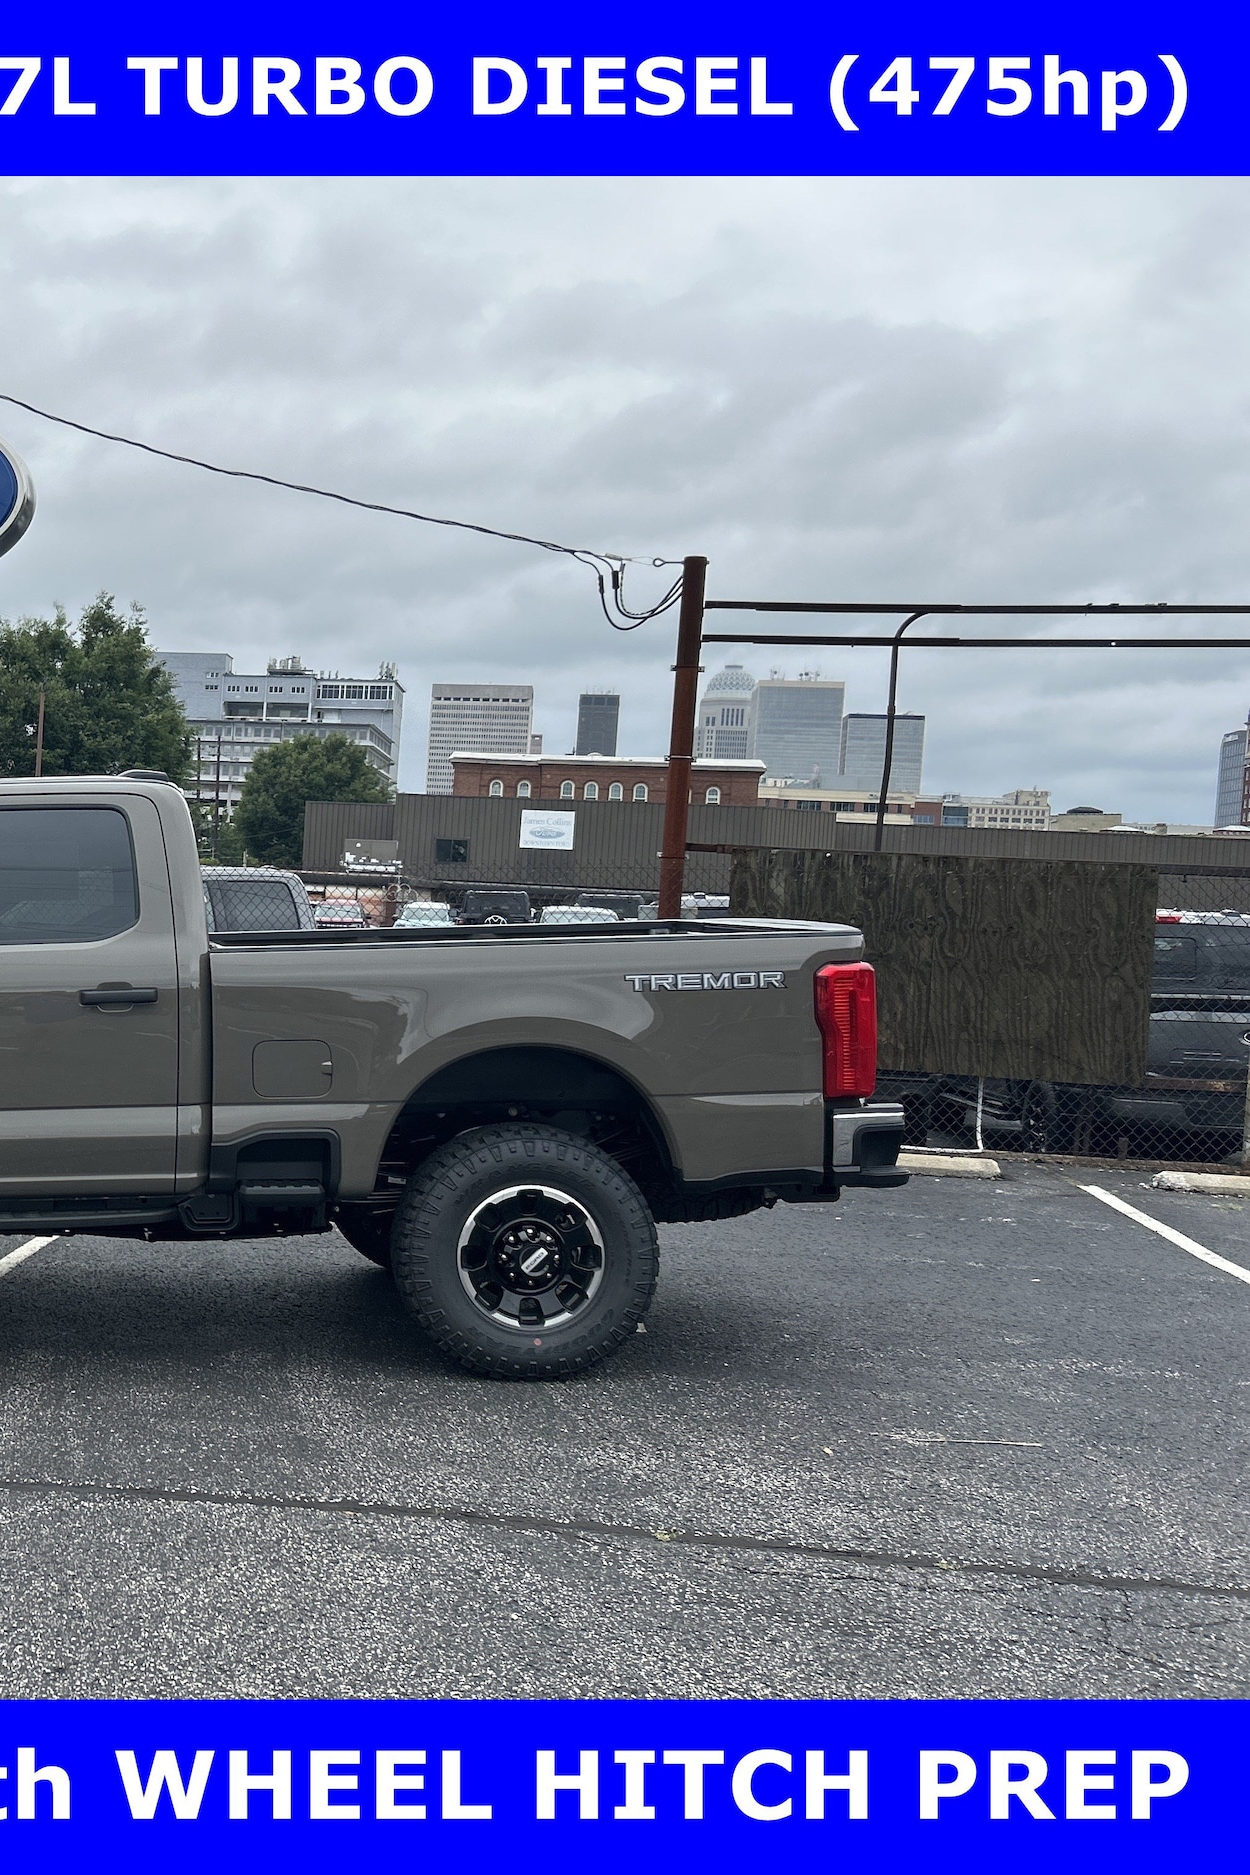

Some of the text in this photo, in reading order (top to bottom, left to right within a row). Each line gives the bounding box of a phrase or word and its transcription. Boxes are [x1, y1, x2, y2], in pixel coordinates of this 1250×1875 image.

[523, 817, 572, 826] James Collins
[624, 971, 787, 992] TREMOR
